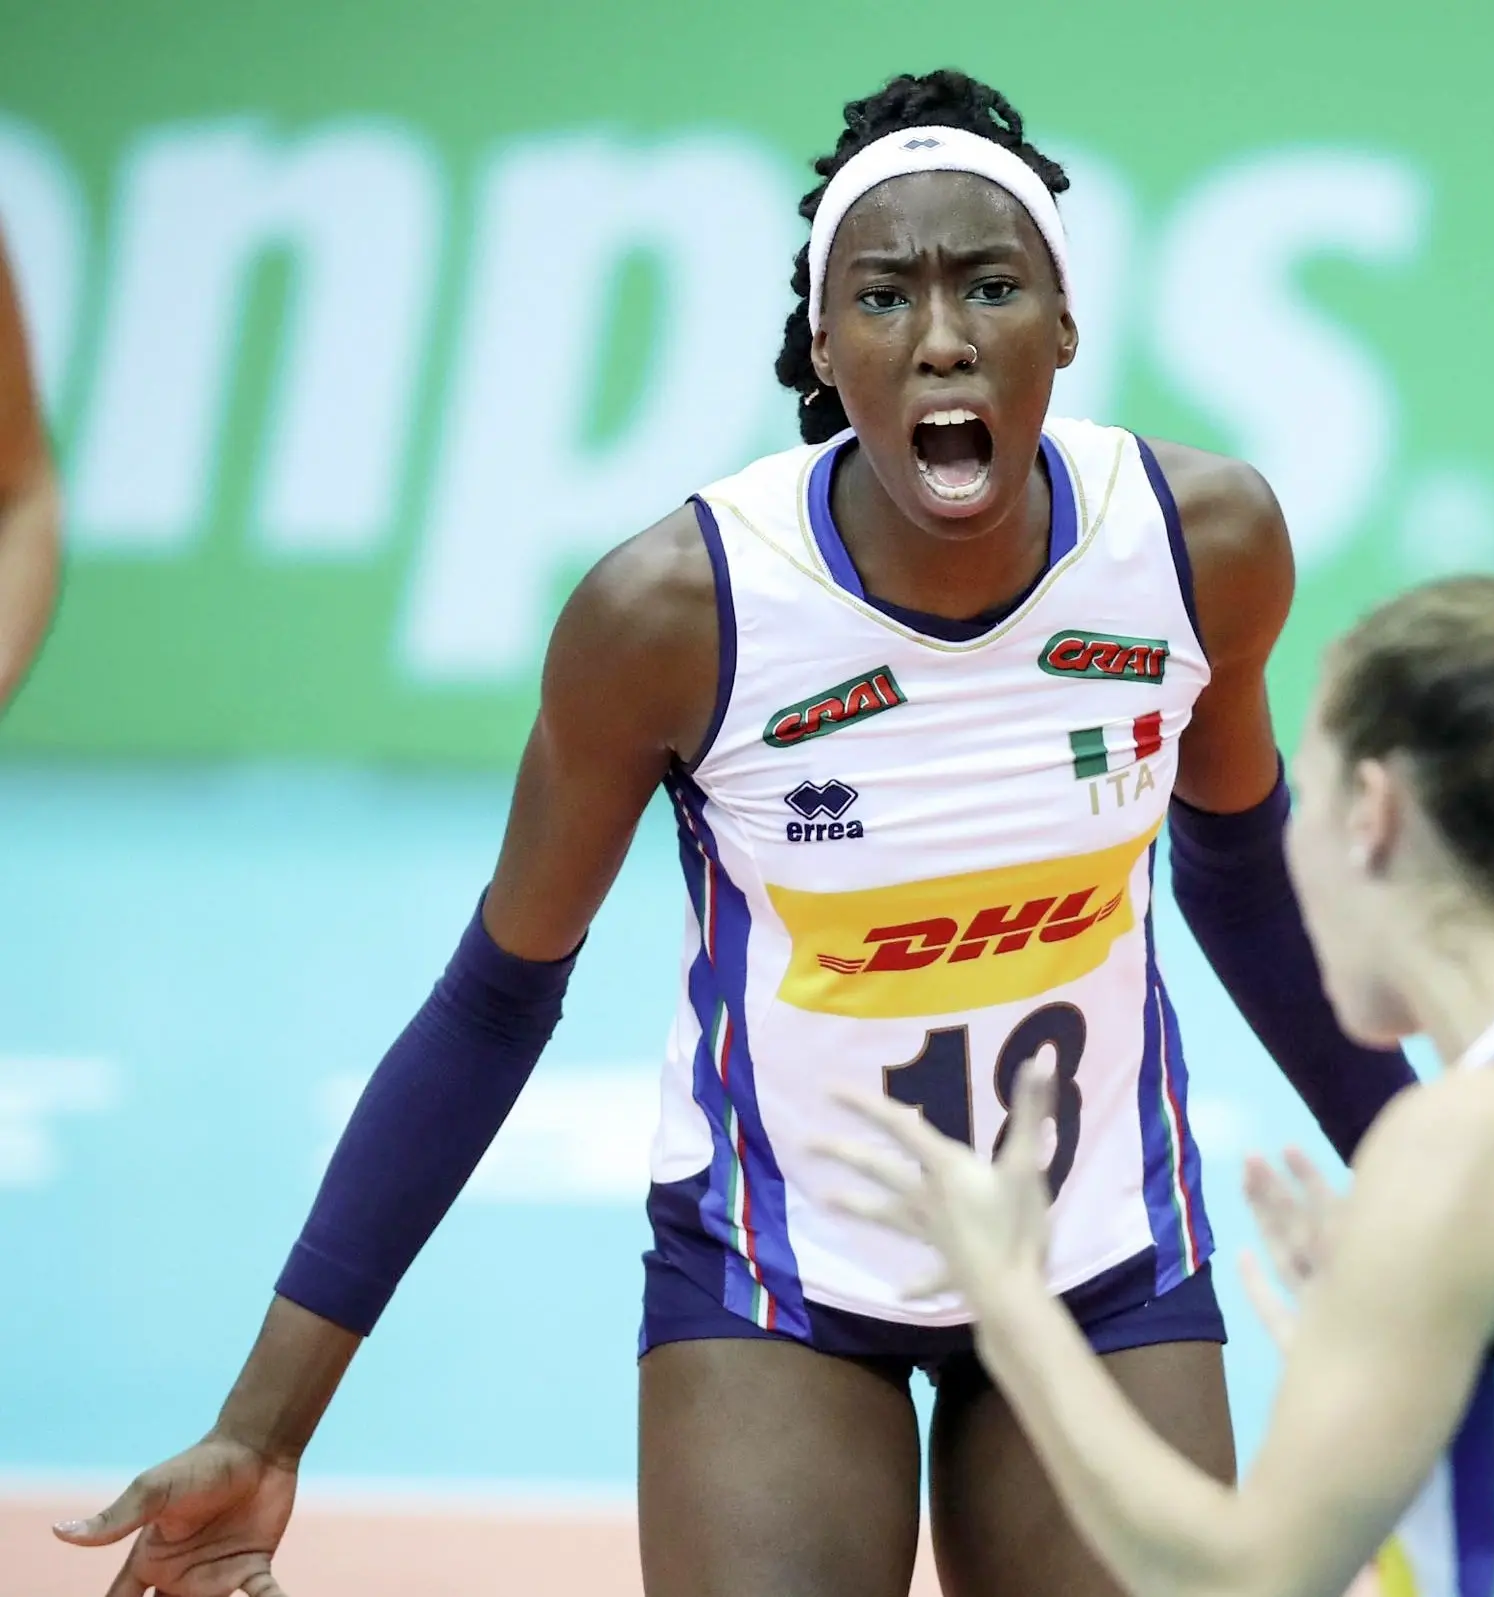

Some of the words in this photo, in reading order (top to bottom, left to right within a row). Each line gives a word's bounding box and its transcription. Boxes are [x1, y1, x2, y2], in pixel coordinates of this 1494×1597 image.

[1047, 638, 1168, 678] CRAI
[773, 673, 899, 743] CRAI
[1089, 763, 1155, 815] ITA
[787, 820, 864, 842] errea
[862, 885, 1102, 974] DHL
[881, 1001, 1087, 1207] 18
